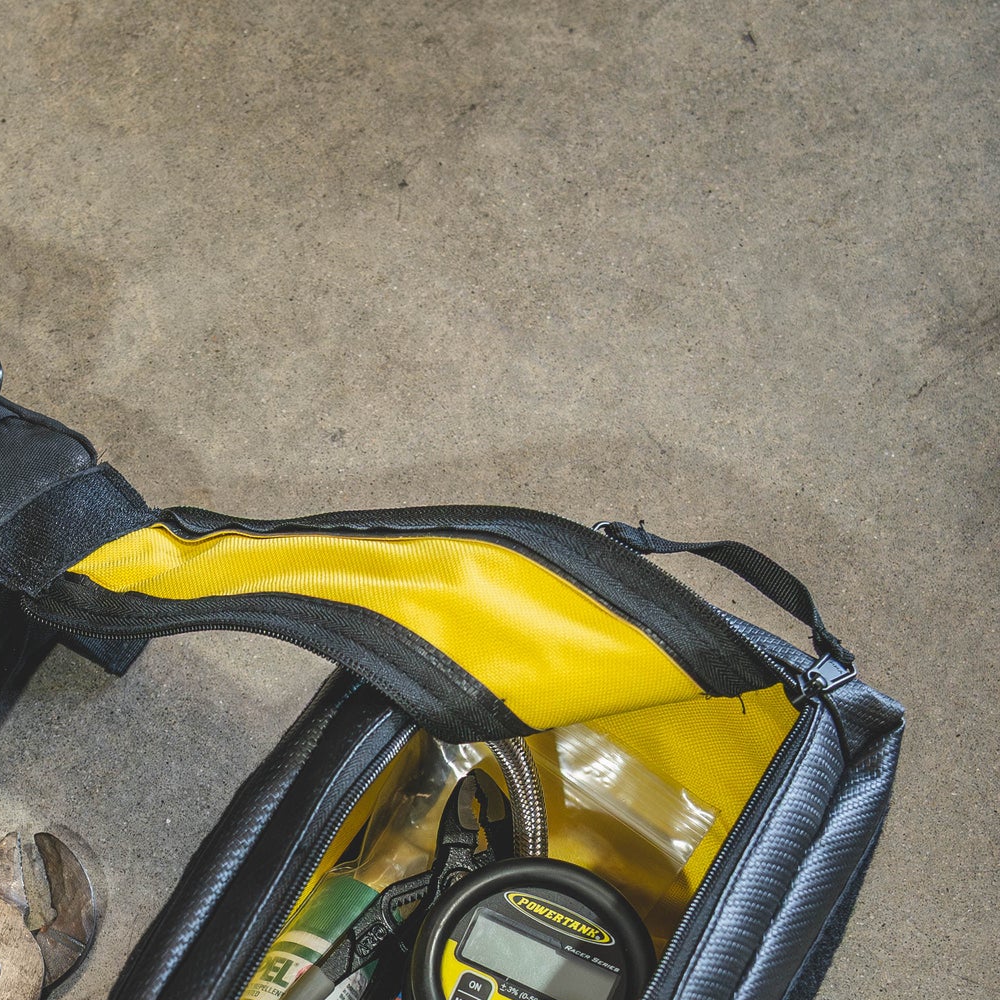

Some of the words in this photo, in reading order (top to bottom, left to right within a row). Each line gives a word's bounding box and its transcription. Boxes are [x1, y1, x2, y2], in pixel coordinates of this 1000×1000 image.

[517, 896, 600, 939] POWERTANK
[252, 982, 284, 998] EPELLEN
[468, 980, 483, 992] ON
